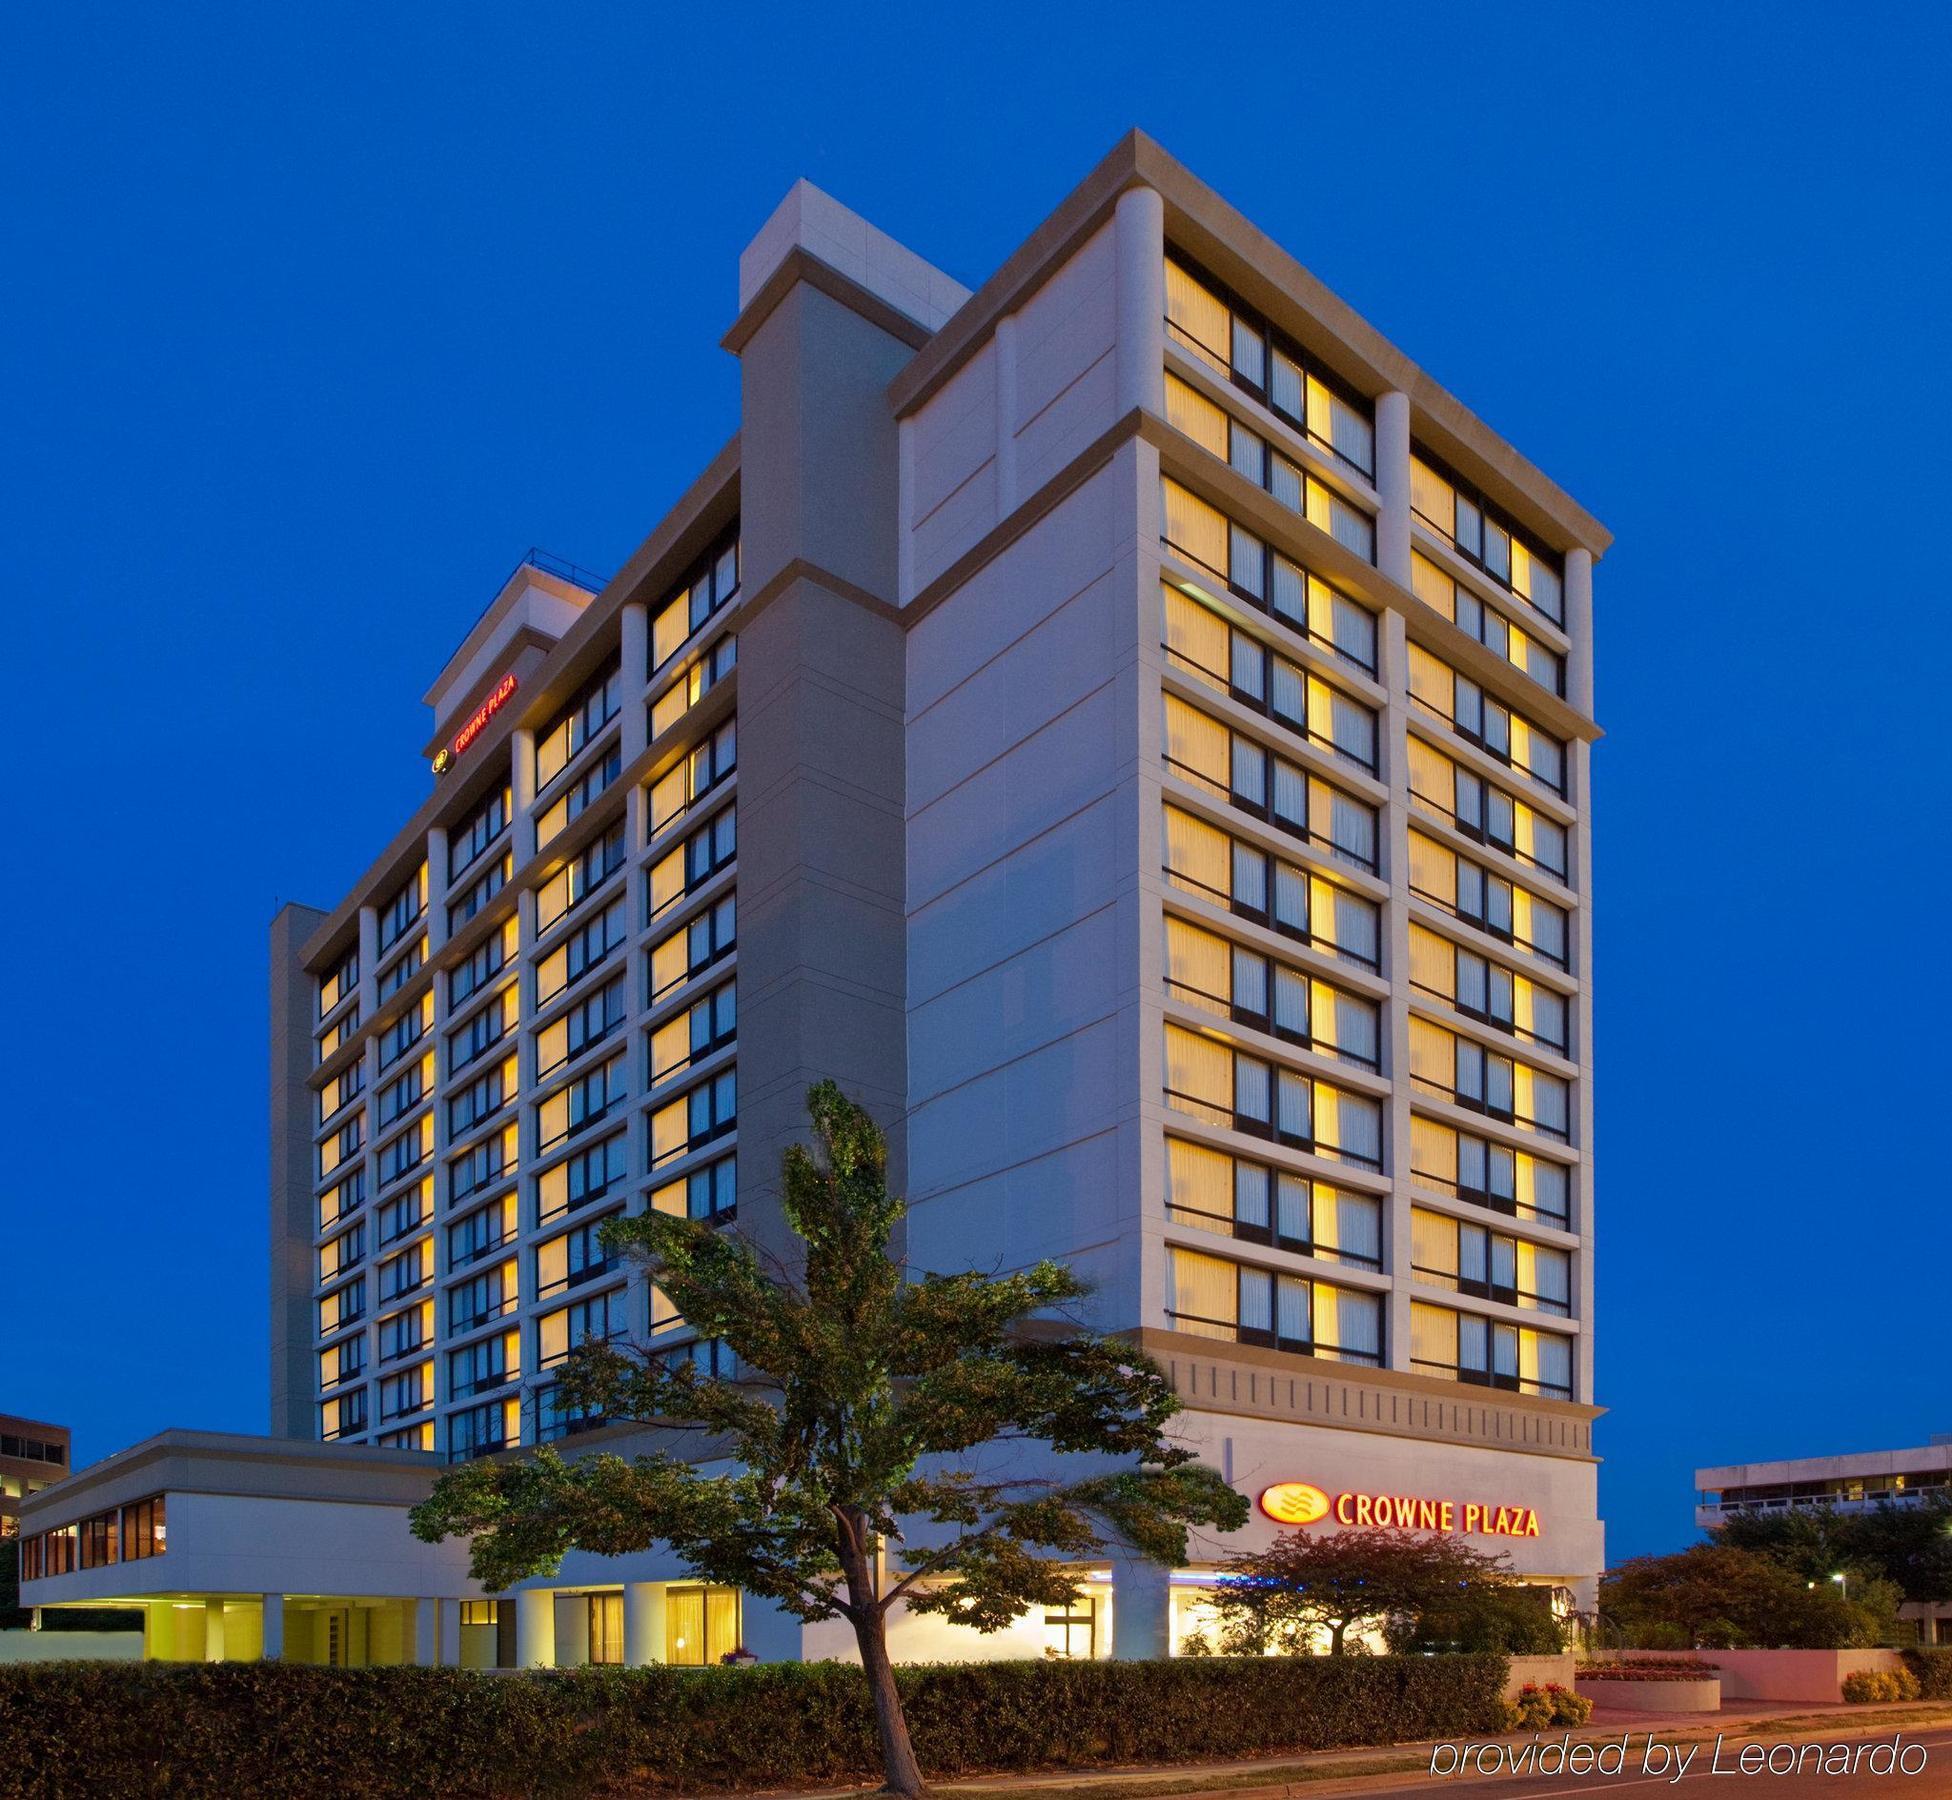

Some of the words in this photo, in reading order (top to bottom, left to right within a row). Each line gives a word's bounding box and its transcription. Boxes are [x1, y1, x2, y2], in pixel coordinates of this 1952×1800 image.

[455, 707, 487, 753] CROWNE
[488, 674, 515, 714] PLAZA
[1337, 1493, 1454, 1531] CROWNE
[1464, 1503, 1540, 1537] PLAZA
